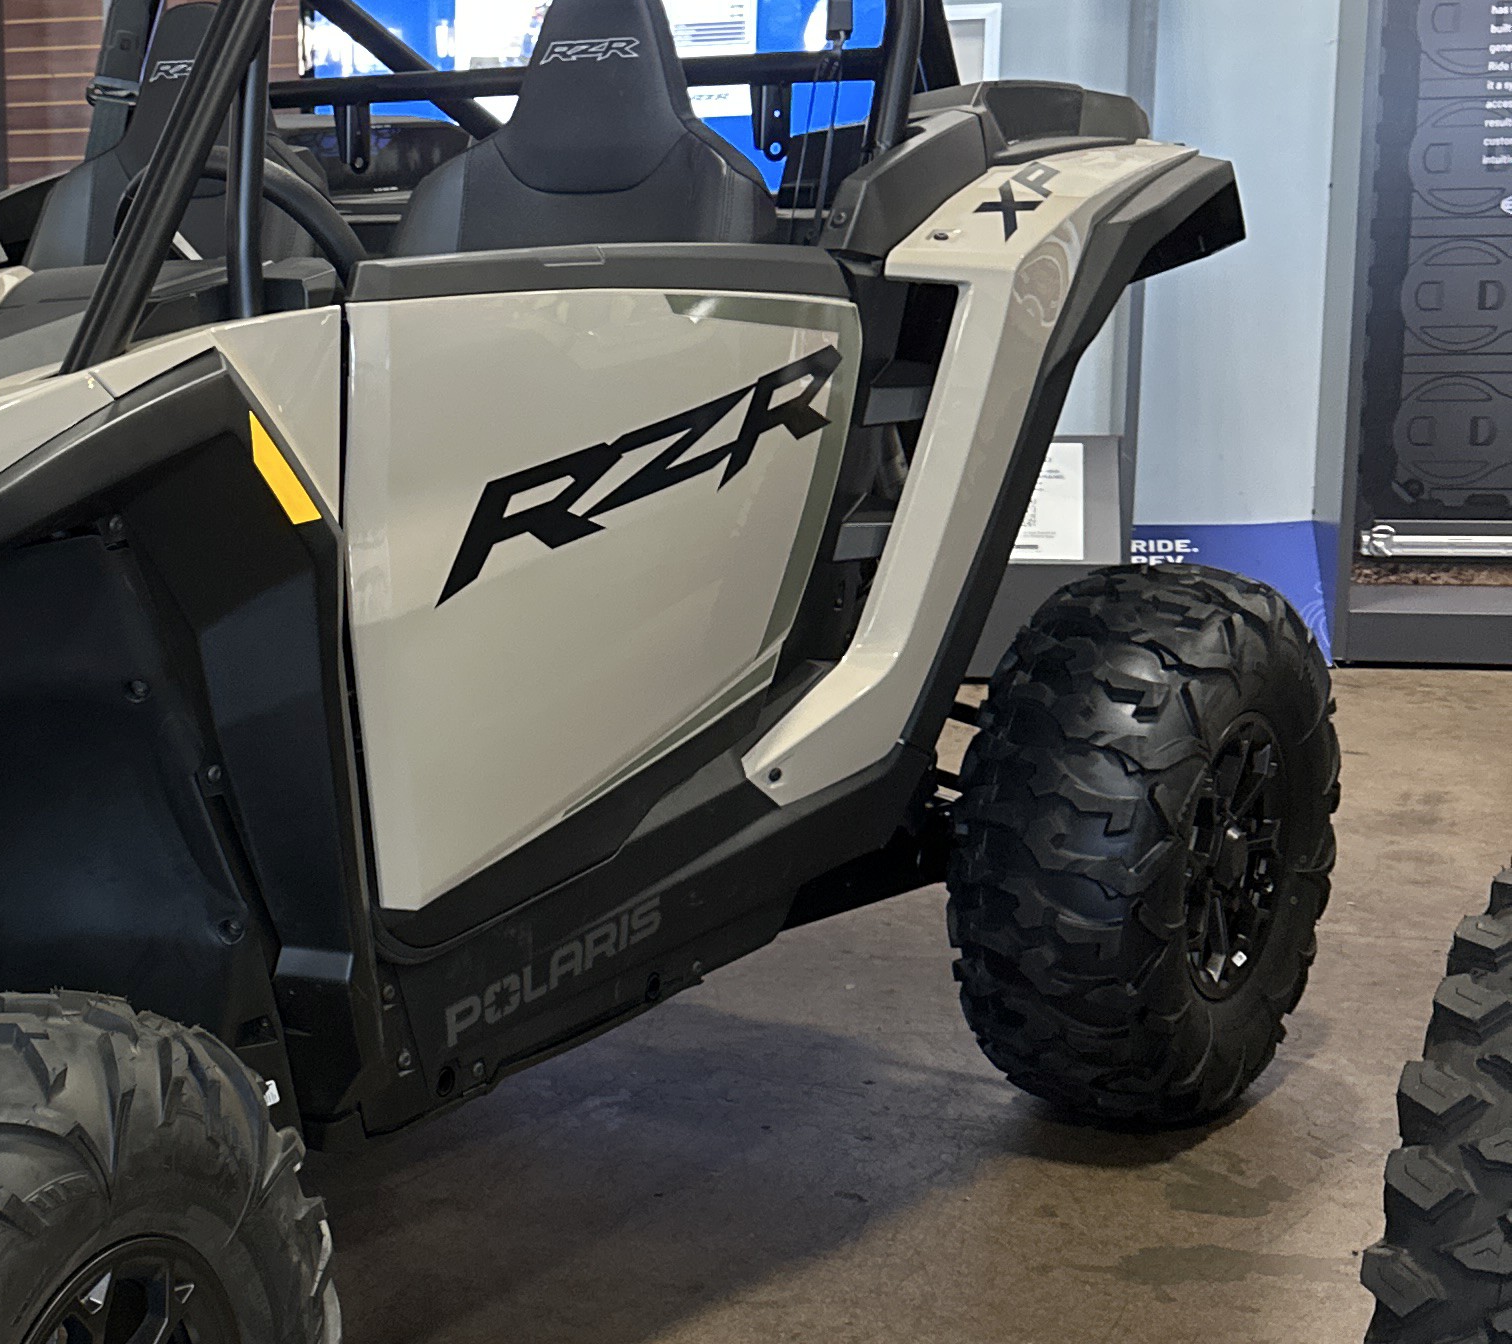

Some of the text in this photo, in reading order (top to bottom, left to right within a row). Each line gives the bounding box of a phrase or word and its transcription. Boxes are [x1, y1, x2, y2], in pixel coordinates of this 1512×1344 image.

[149, 59, 195, 83] RZ
[540, 37, 639, 66] RZR
[973, 161, 1060, 243] XP
[434, 344, 842, 609] RZR
[1131, 539, 1199, 553] RIDE.
[445, 895, 662, 1048] POLARIS
